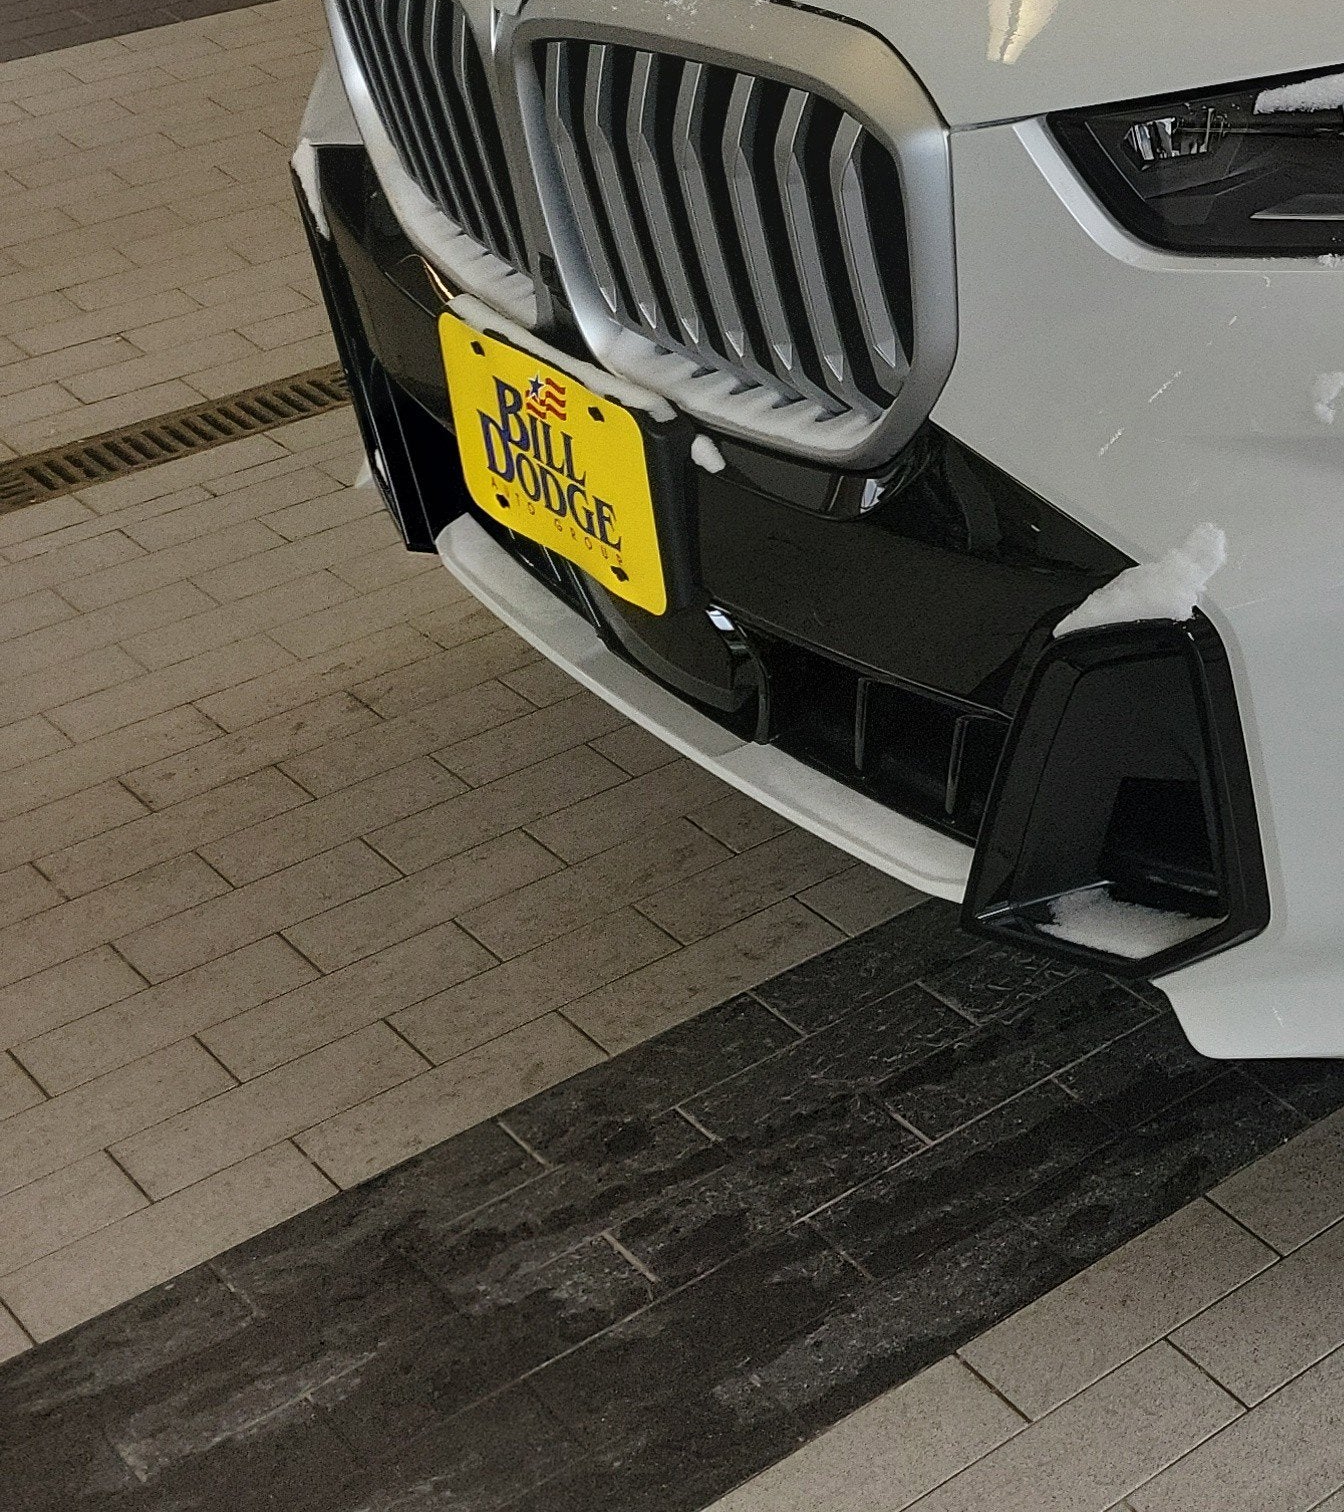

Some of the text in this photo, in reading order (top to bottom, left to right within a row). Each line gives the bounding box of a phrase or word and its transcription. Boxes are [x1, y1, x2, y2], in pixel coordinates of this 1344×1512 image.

[477, 408, 622, 552] DODGE
[493, 375, 586, 486] BILL
[492, 477, 536, 516] AUTO
